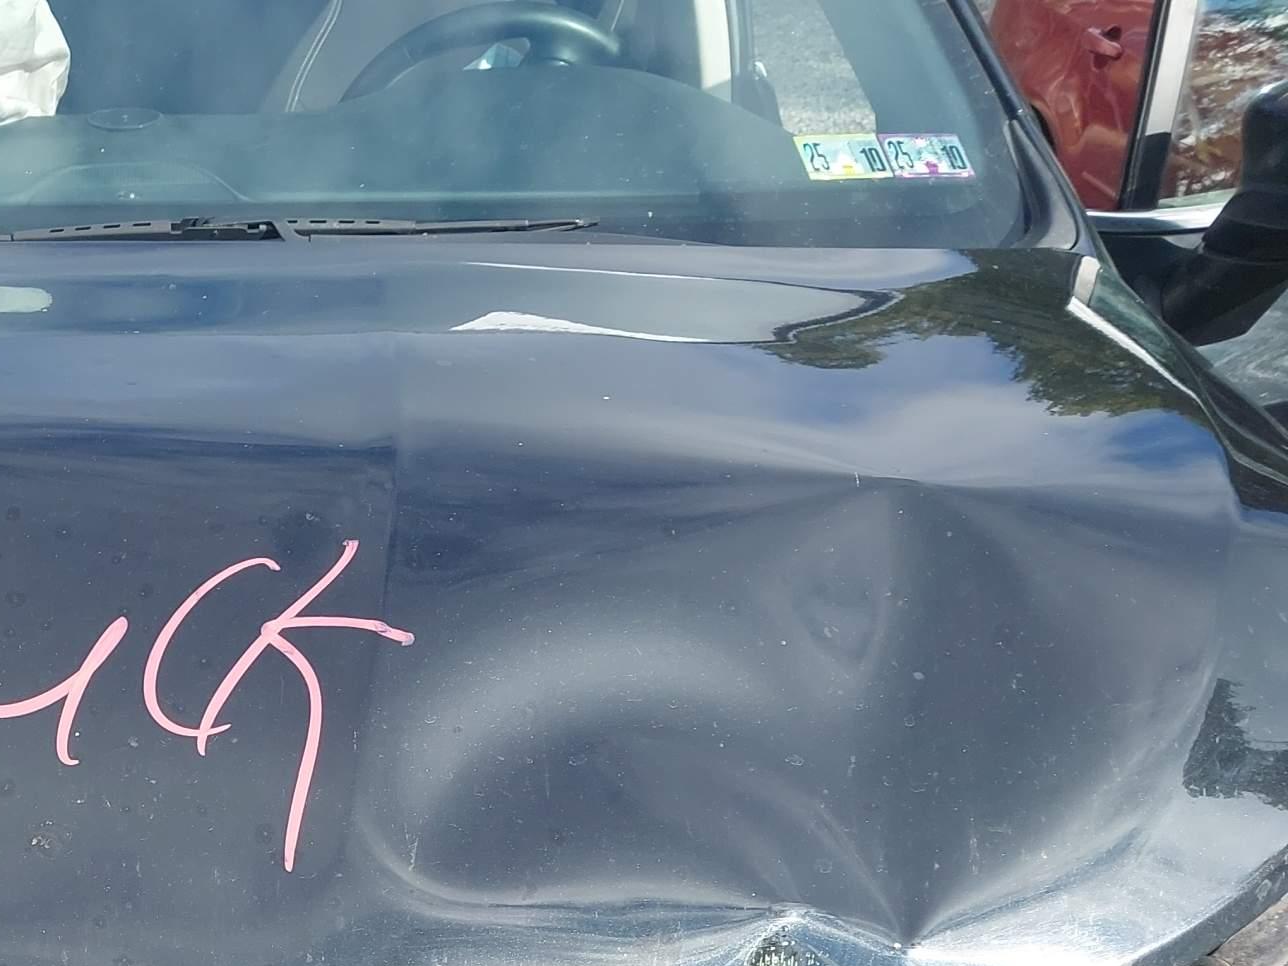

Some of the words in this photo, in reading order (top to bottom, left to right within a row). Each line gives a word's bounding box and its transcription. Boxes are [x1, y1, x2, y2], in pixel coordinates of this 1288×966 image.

[803, 142, 830, 172] 25
[860, 147, 886, 172] 10
[887, 140, 914, 169] 25
[942, 145, 968, 170] 10
